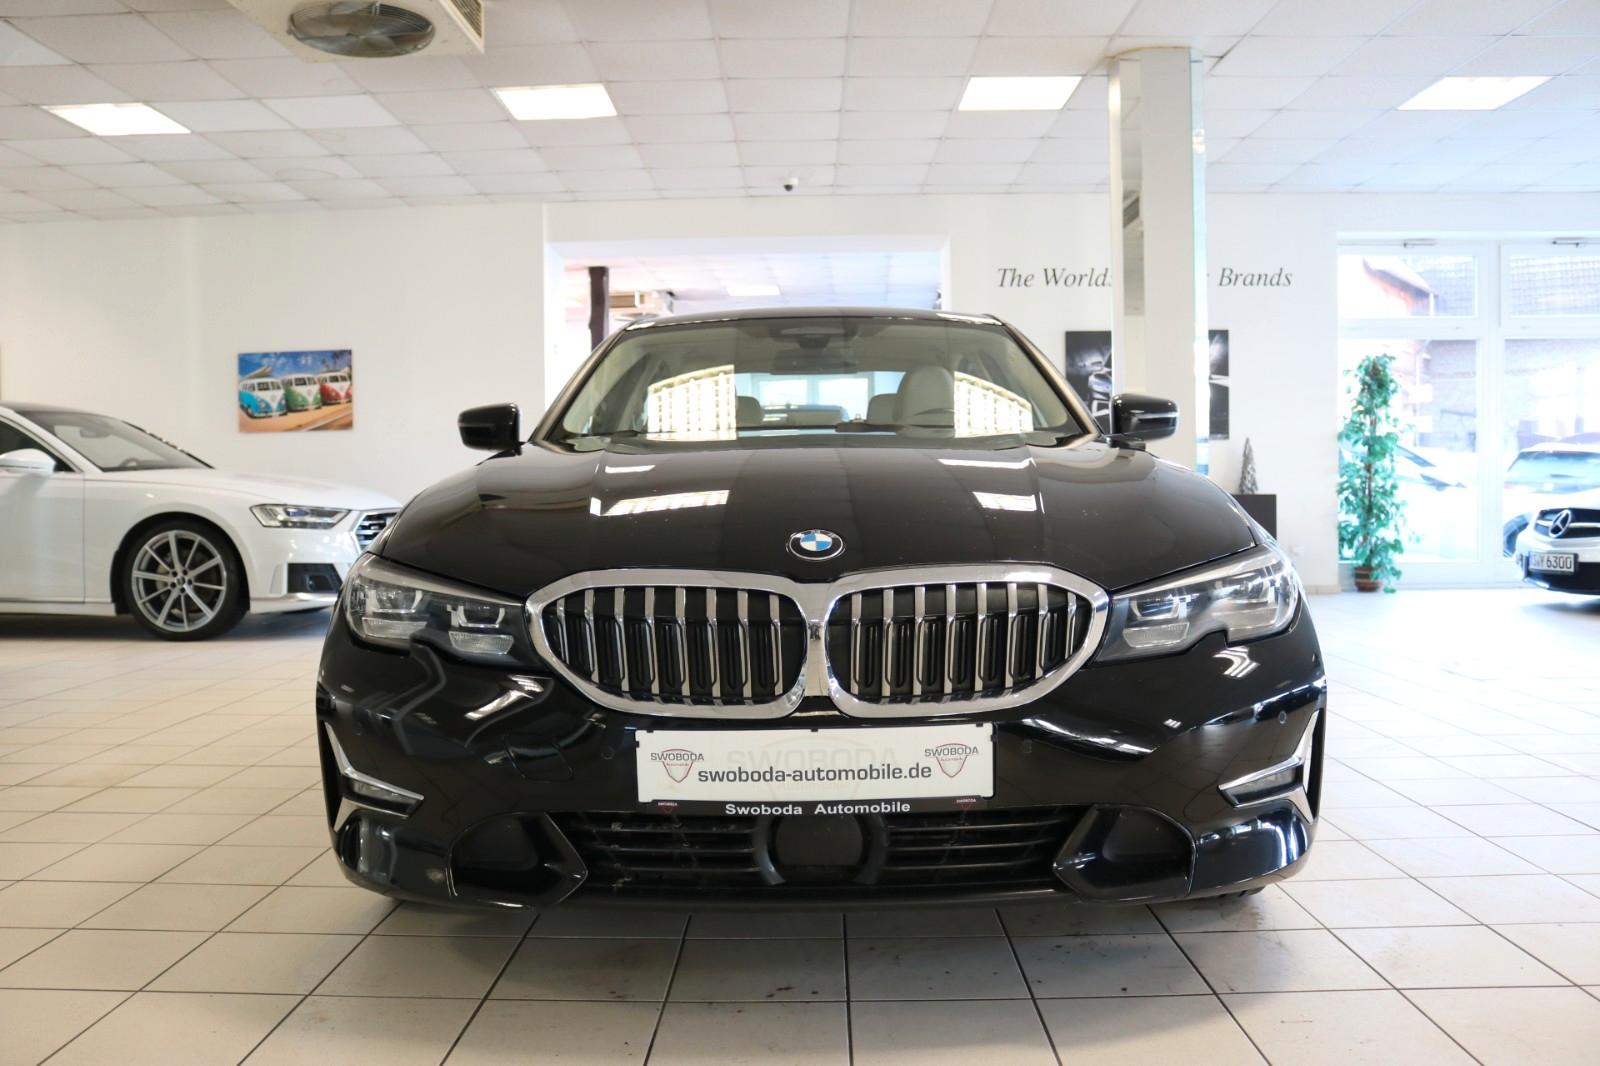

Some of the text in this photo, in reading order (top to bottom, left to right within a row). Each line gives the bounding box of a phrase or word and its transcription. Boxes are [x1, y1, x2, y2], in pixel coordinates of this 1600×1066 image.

[997, 267, 1035, 288] The
[1218, 266, 1293, 288] Brands
[1546, 555, 1572, 570] 6300
[650, 752, 704, 761] SWOBODA
[924, 746, 979, 757] SWOBODA
[698, 762, 932, 783] swoboda-automobile.de
[725, 801, 911, 815] Swoboda Automobile
